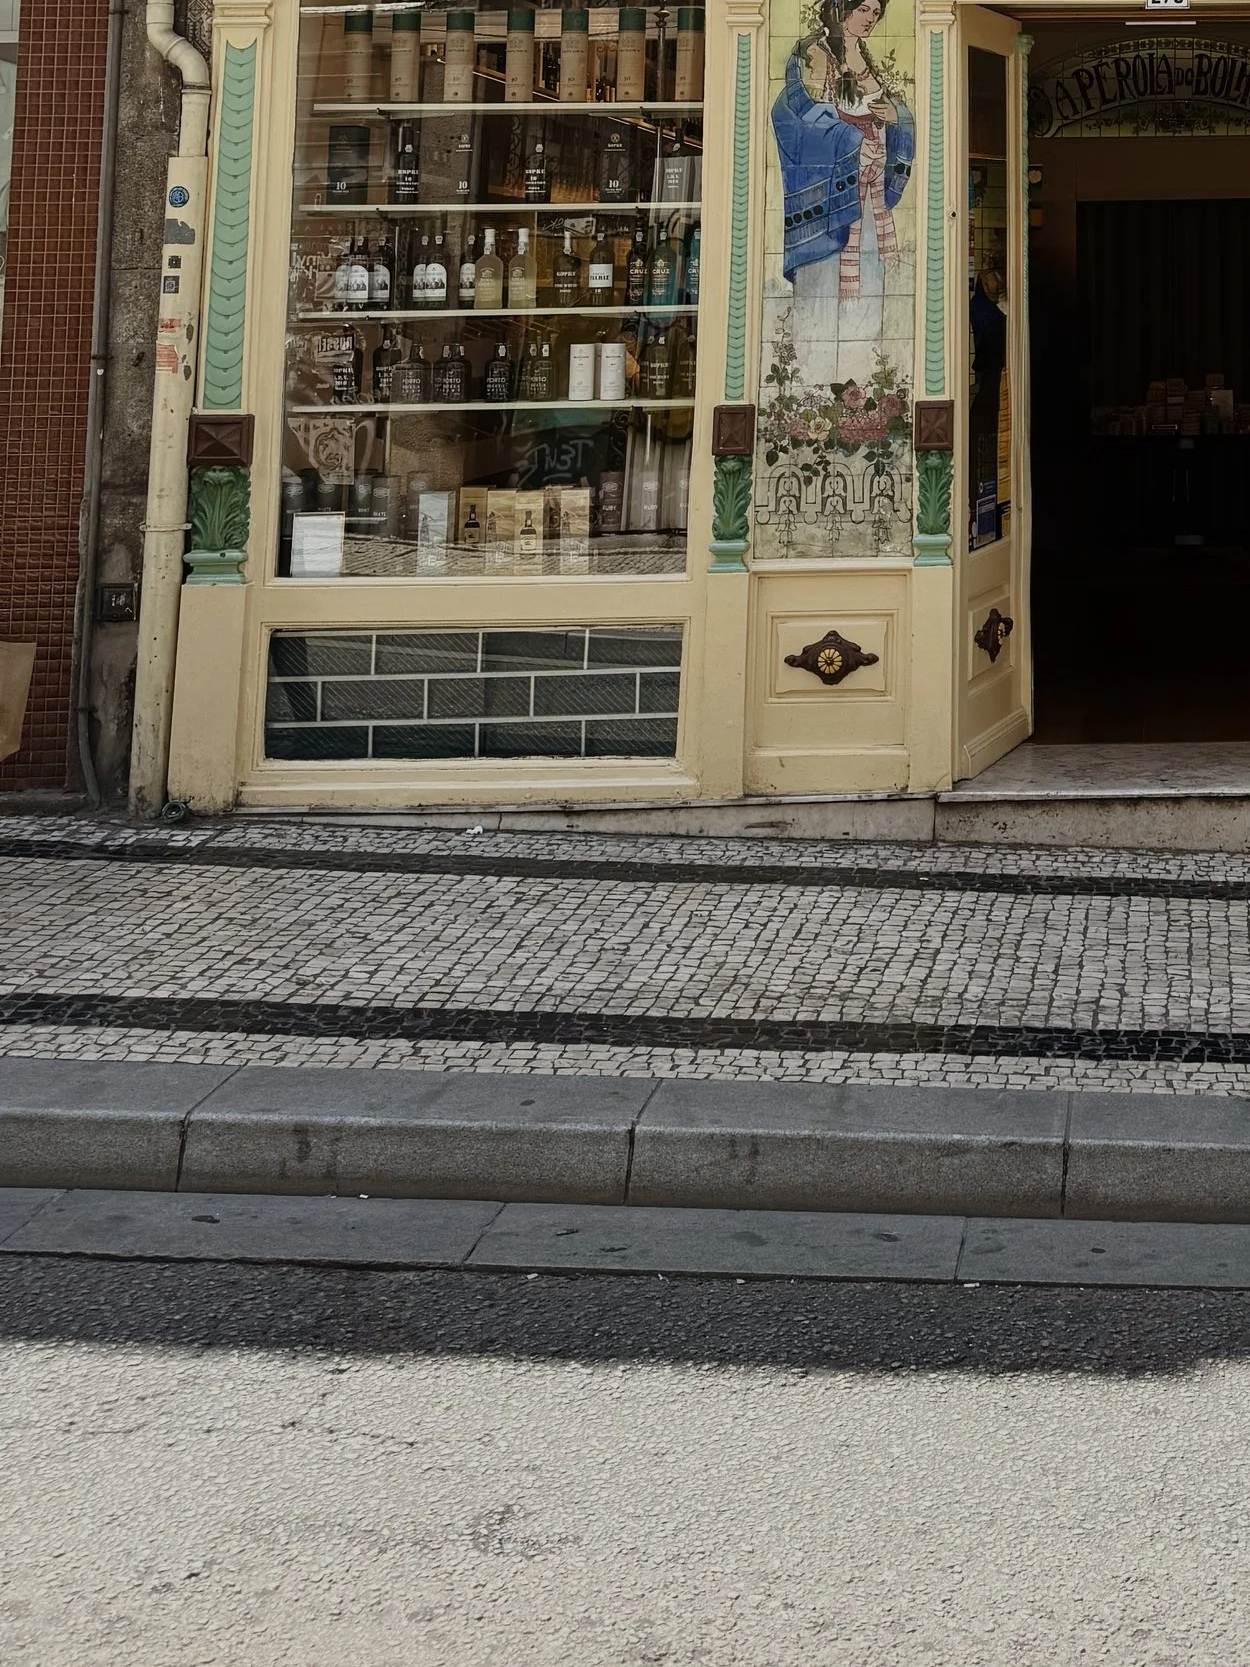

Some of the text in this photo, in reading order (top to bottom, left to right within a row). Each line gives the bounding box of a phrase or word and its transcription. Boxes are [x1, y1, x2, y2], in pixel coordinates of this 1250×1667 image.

[1055, 79, 1080, 120] A
[1072, 52, 1175, 112] PÉROLA
[1174, 67, 1193, 87] DO
[336, 181, 347, 190] 10
[458, 180, 468, 189] 10
[608, 179, 619, 188] 10
